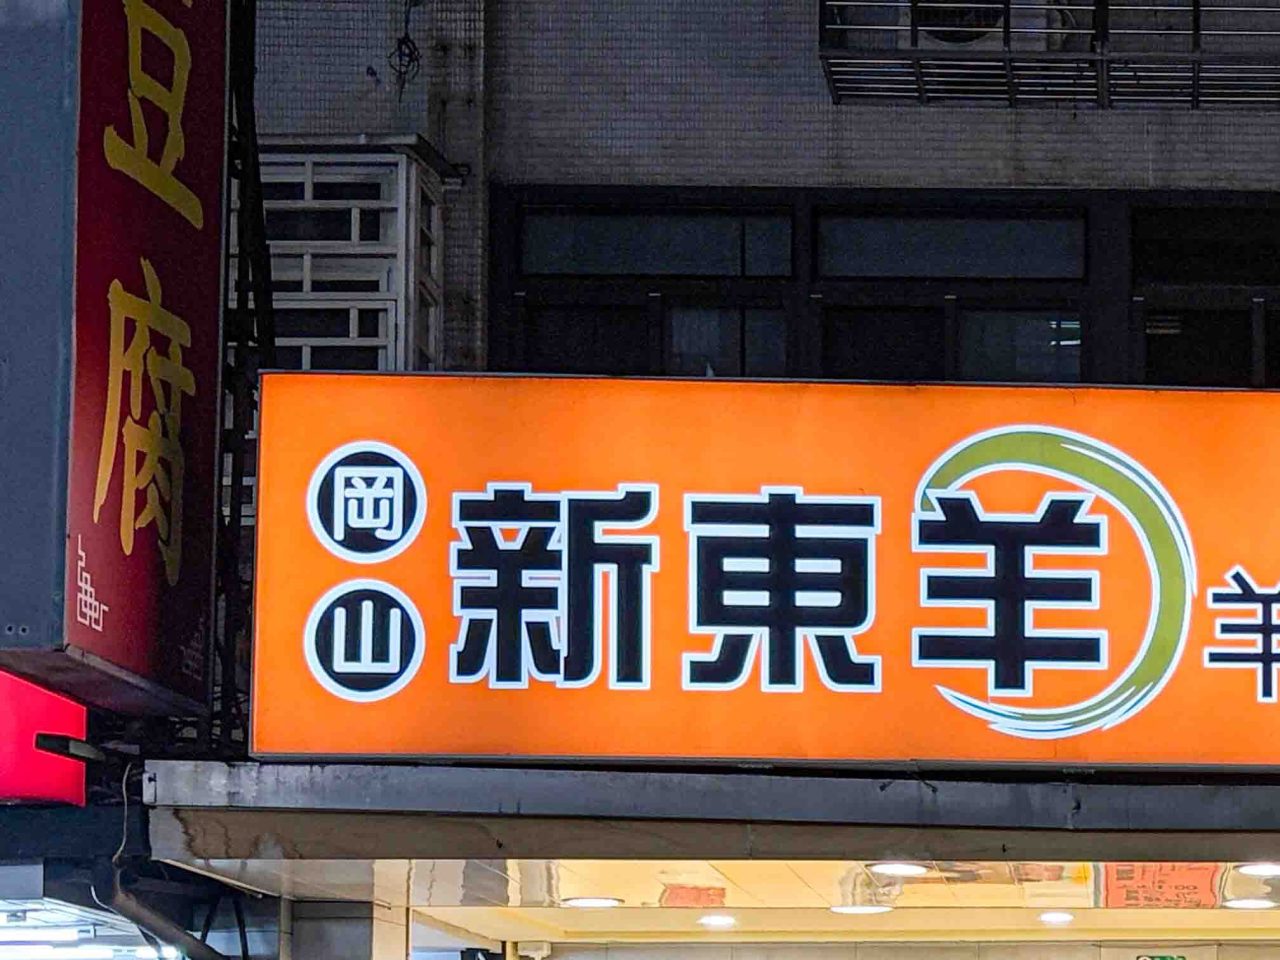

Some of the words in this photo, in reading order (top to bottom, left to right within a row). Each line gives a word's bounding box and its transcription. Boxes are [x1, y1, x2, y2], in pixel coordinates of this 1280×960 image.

[326, 458, 411, 684] 岡山
[450, 483, 1108, 696] 新東羊
